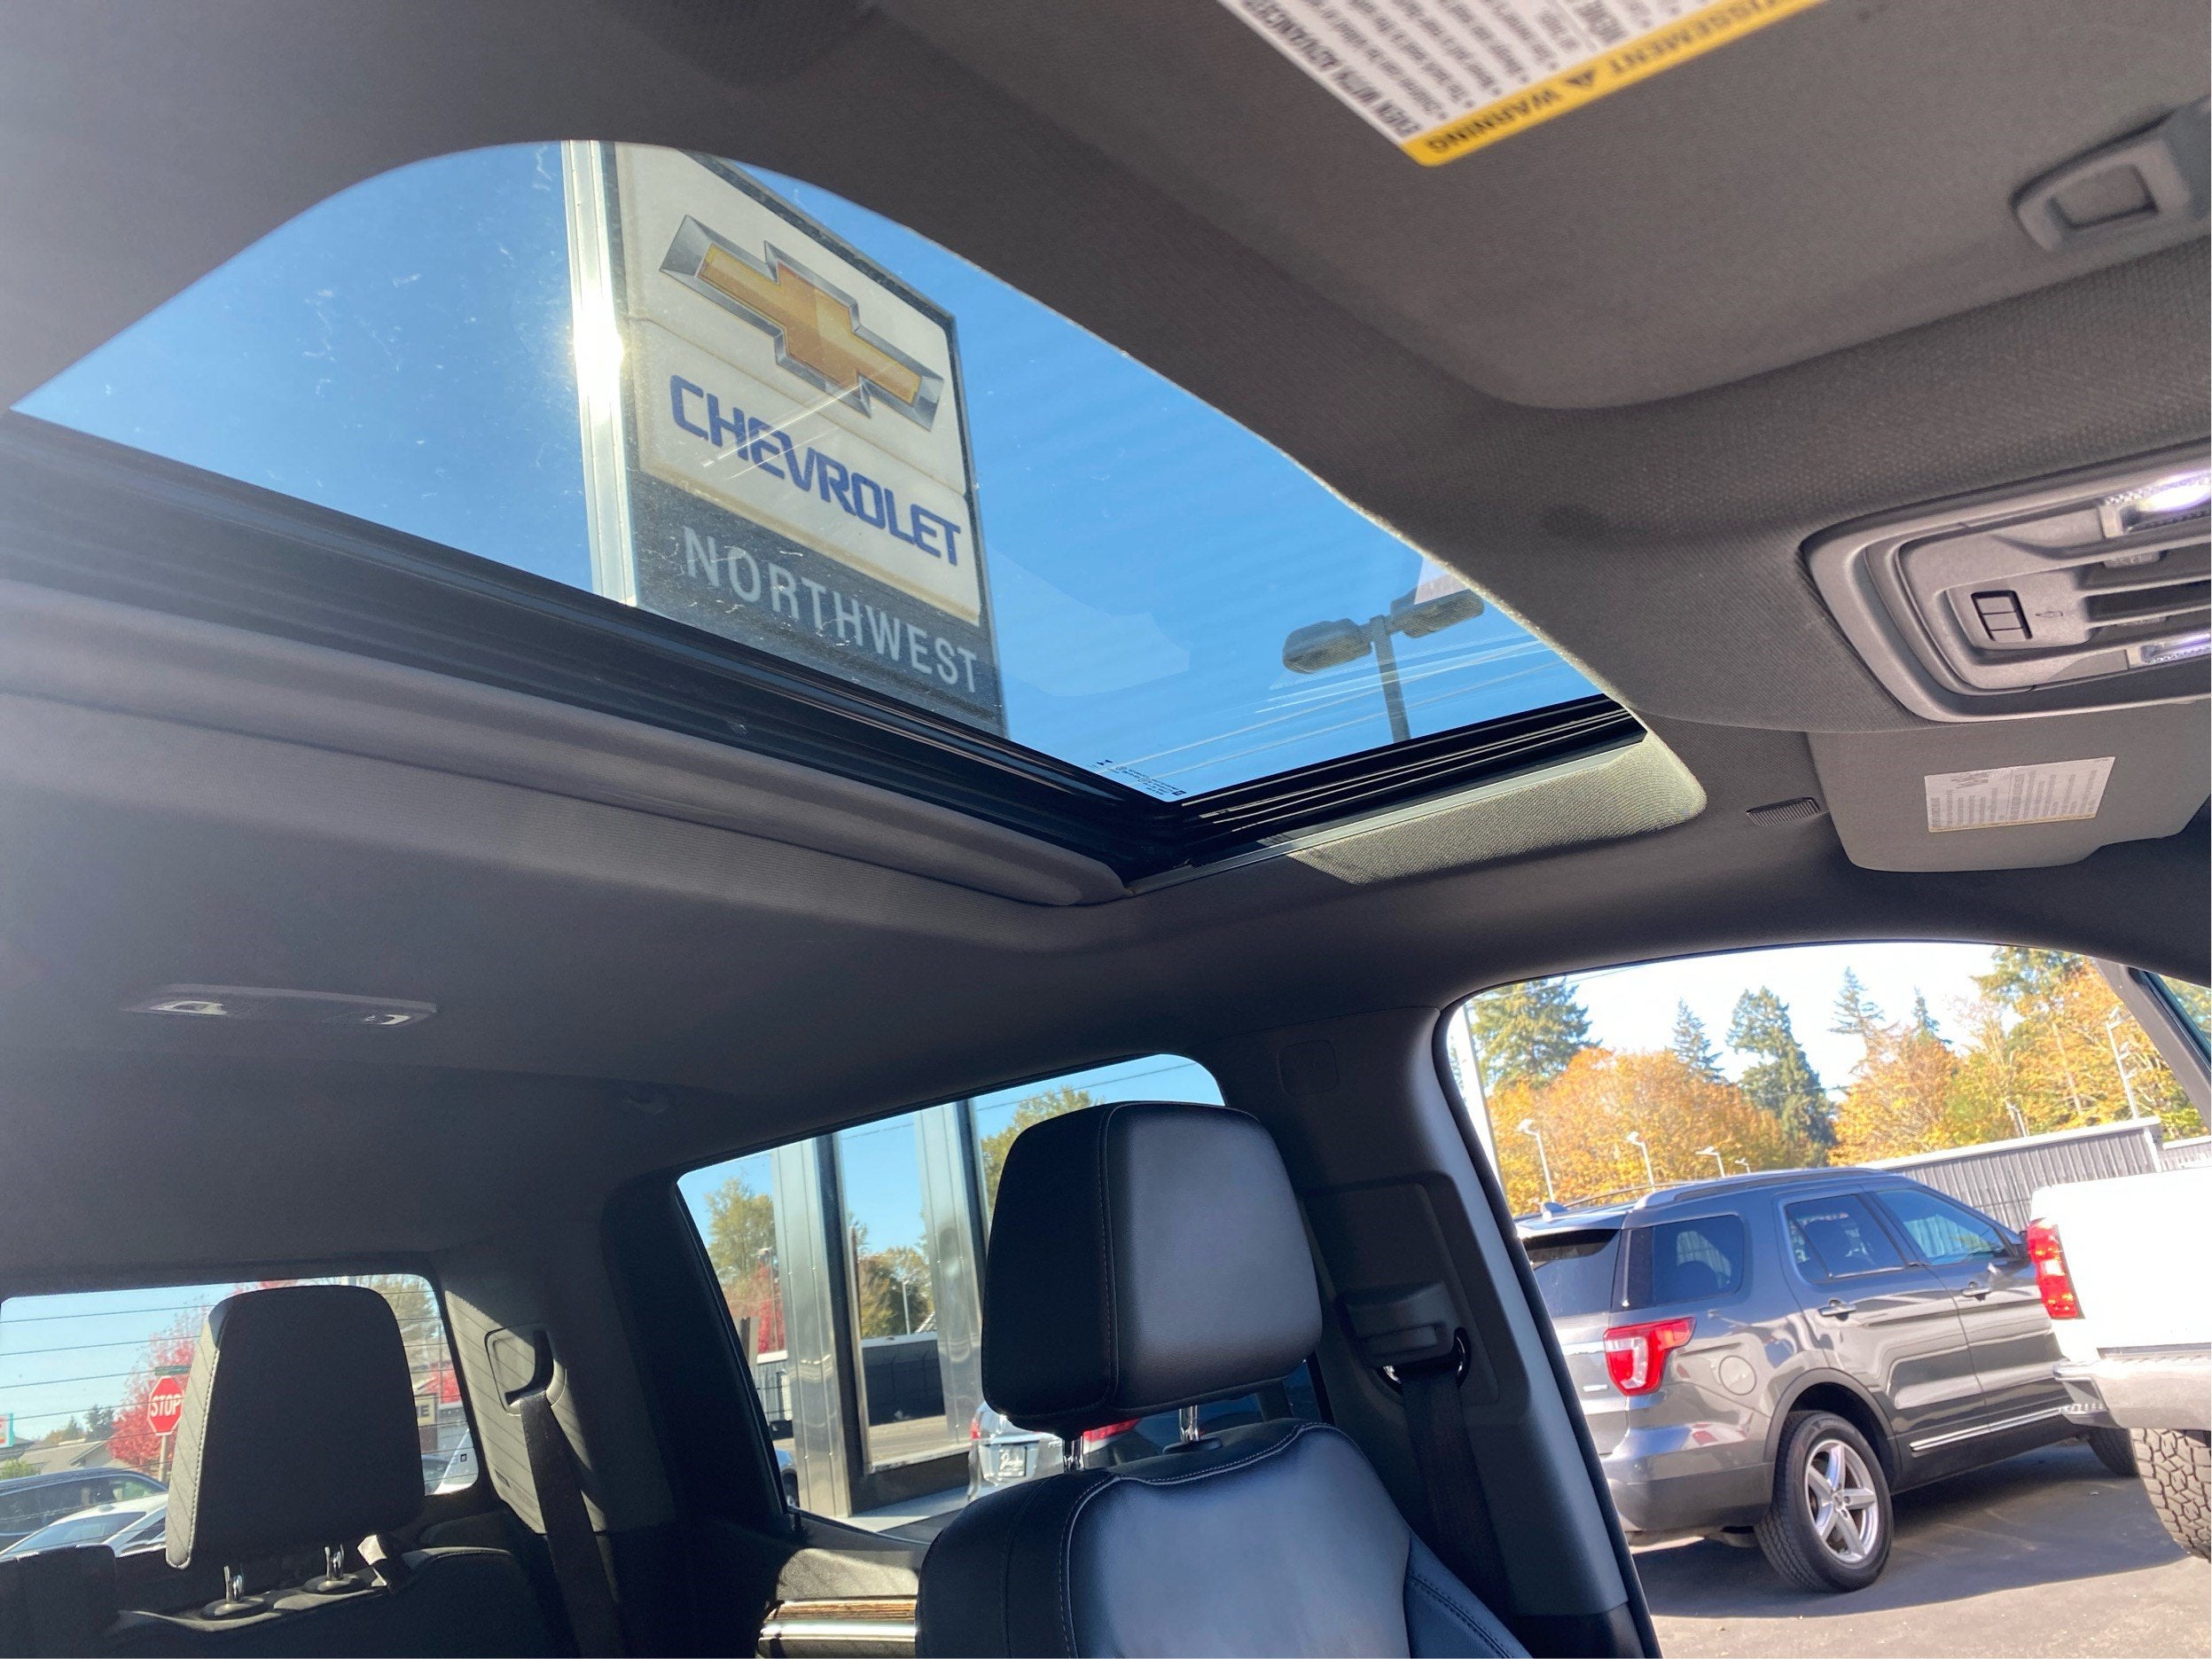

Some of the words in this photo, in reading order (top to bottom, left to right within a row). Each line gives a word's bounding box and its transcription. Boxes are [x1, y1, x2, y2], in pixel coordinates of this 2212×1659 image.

[1424, 89, 1561, 154] WARNING
[669, 374, 961, 566] CHEVROLET
[684, 527, 976, 693] NORTHWEST
[151, 1394, 182, 1417] STOP
